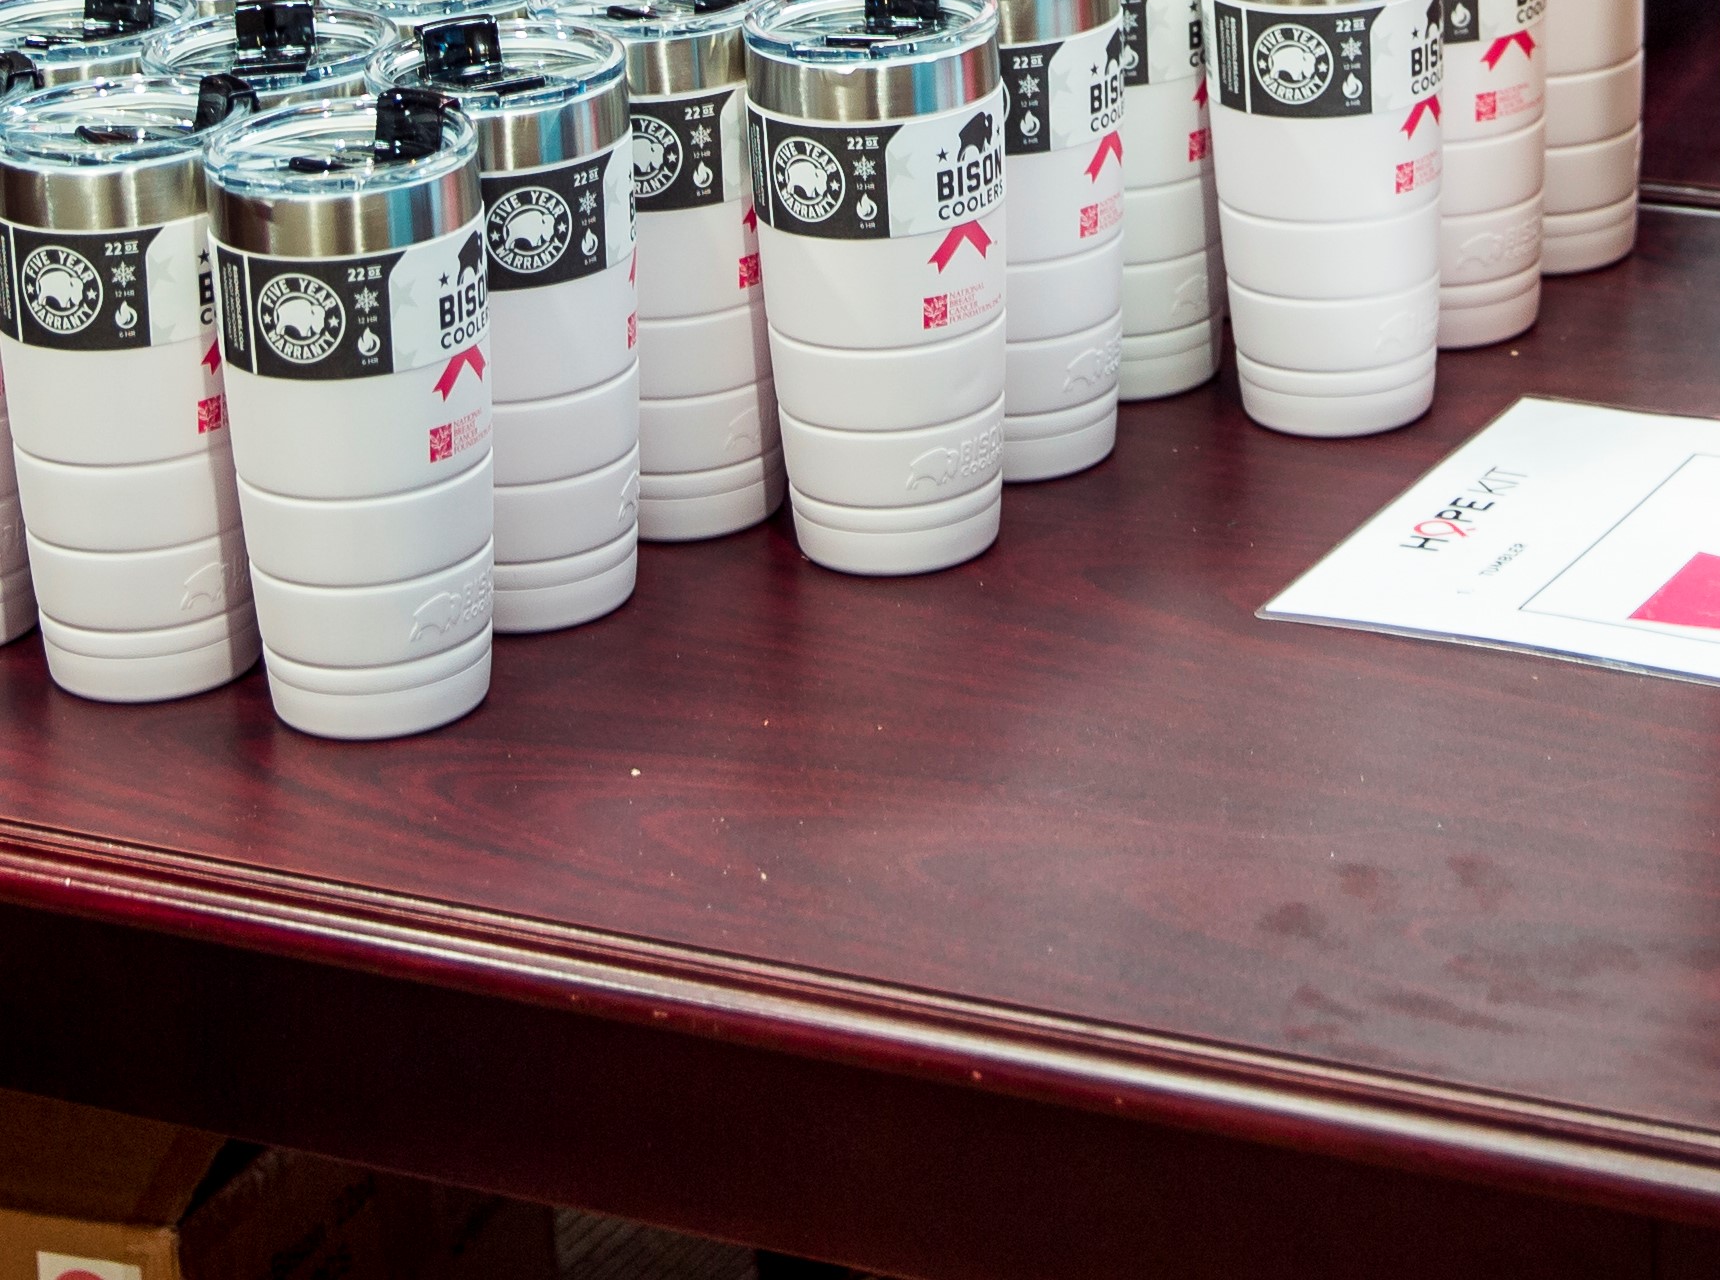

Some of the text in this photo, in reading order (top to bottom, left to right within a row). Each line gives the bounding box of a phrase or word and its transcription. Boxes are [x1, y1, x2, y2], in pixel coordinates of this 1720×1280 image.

[1335, 19, 1352, 33] 22
[1258, 28, 1326, 60] FIVE YEAR
[1012, 55, 1029, 70] 22
[1262, 73, 1325, 101] WARRANTY
[684, 106, 701, 121] 22
[639, 119, 675, 148] YEAR
[846, 136, 879, 151] 22 OZ
[776, 141, 838, 176] FIVE YEAR
[573, 167, 600, 188] 22 OZ
[634, 165, 674, 195] RANTY
[856, 183, 876, 191] 12 HR
[936, 144, 1003, 203] BISON
[491, 190, 565, 225] FIVE YEAR
[781, 186, 837, 219] WARRANTY
[938, 179, 1003, 220] COOLERS
[104, 241, 139, 257] 22 OZ
[495, 237, 564, 270] WARRANTY
[26, 249, 94, 284] FIVE YEAR
[347, 265, 382, 282] 22 OZ
[115, 289, 135, 298] 12 HR
[263, 278, 337, 311] FIVE YEAR
[949, 282, 985, 300] NATIONAL
[30, 298, 94, 331] WARRANTY
[357, 315, 378, 325] 12 HR
[268, 329, 336, 360] WARRANTY
[361, 357, 379, 366] 6 HR
[1399, 465, 1529, 553] HOPE KIT
